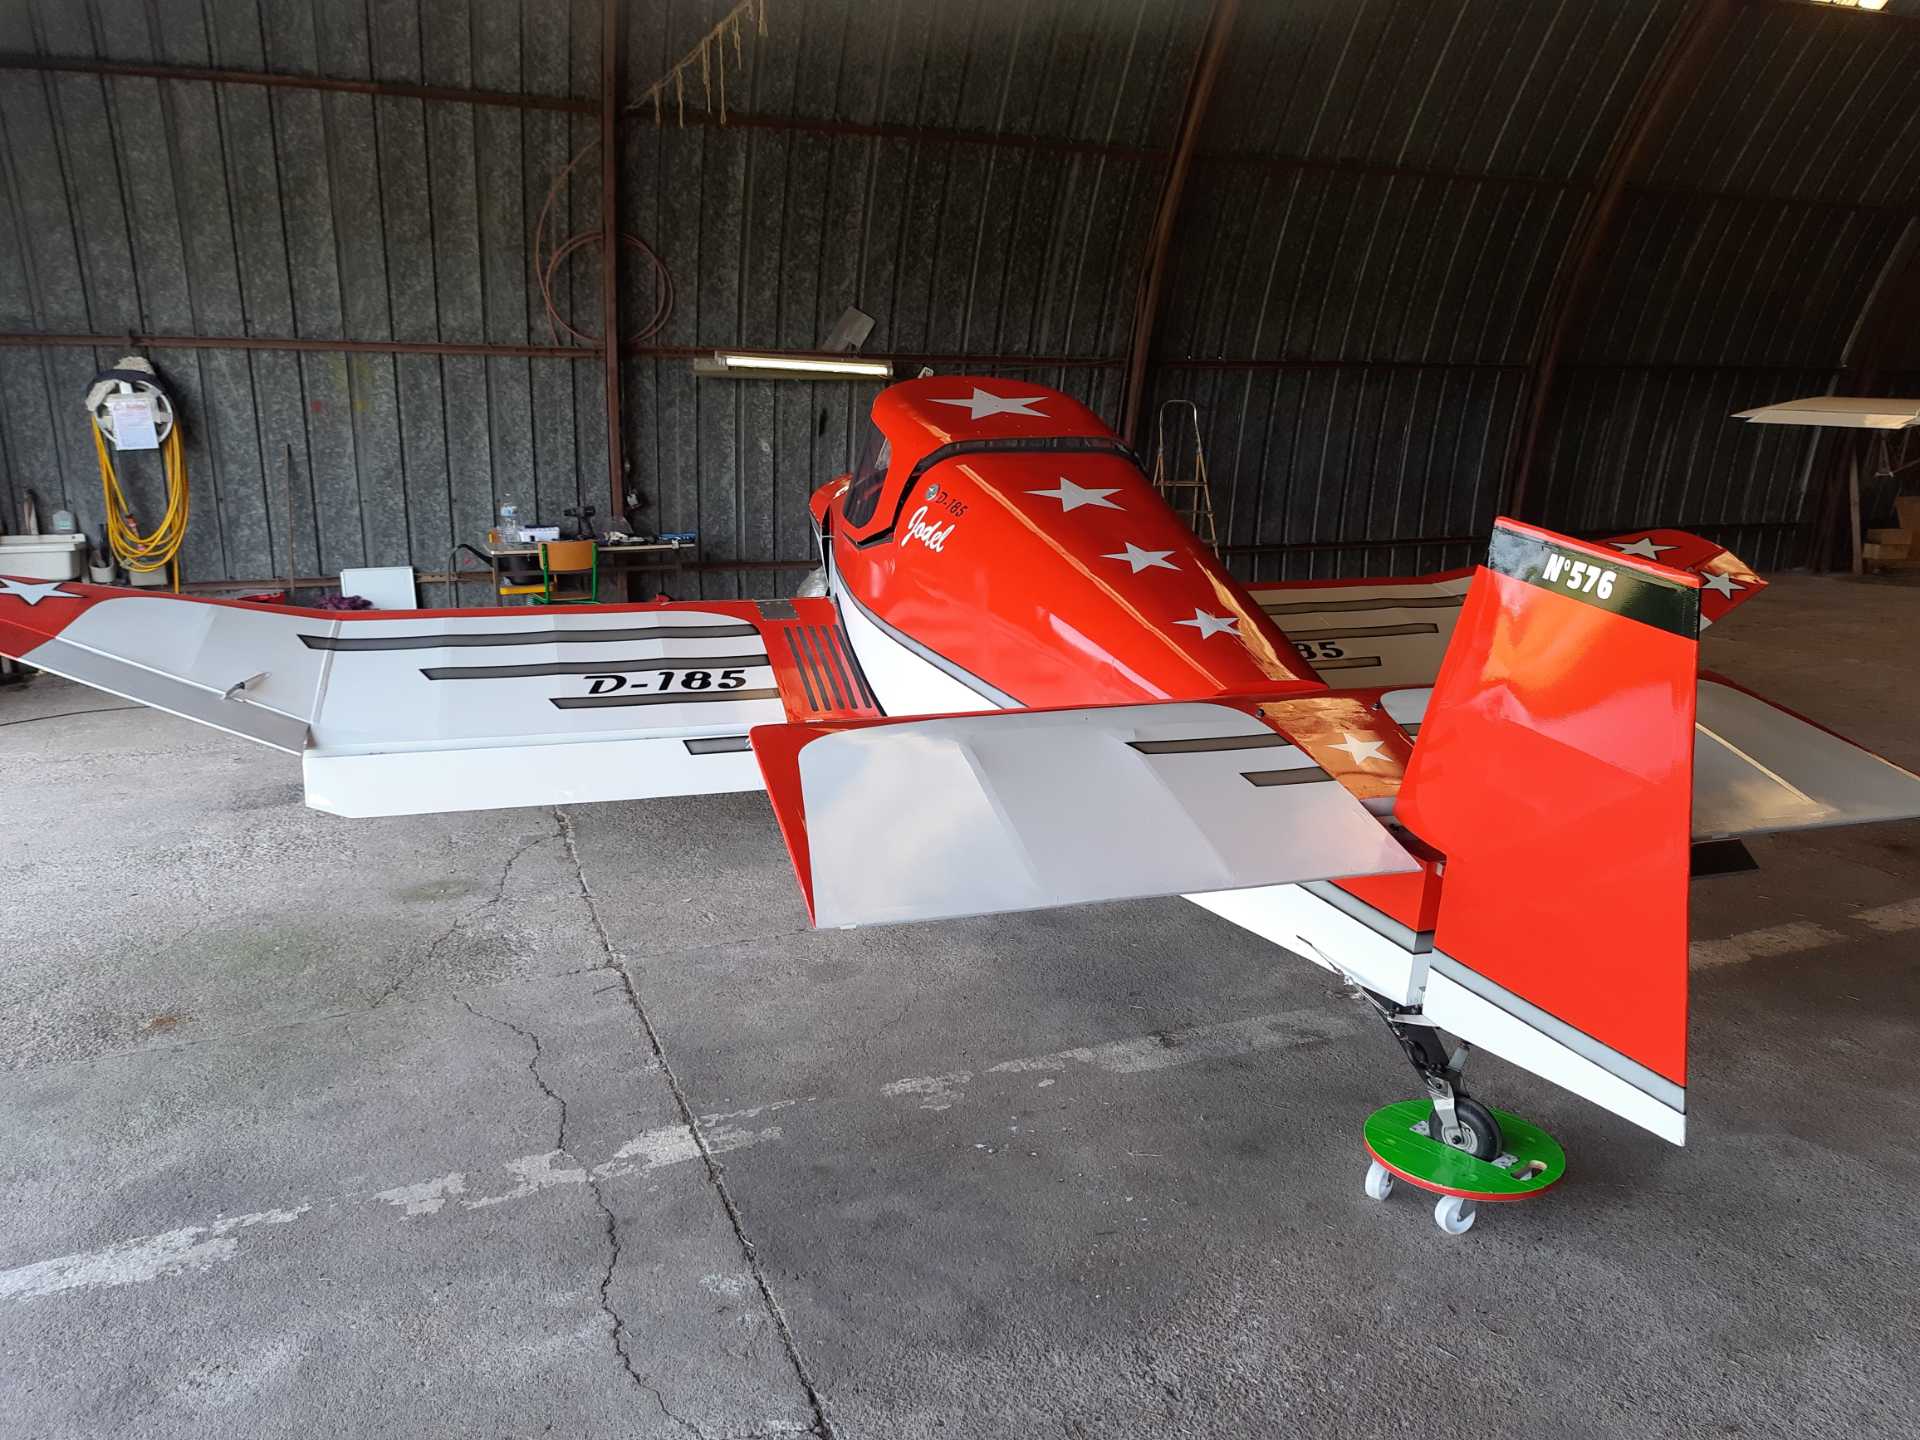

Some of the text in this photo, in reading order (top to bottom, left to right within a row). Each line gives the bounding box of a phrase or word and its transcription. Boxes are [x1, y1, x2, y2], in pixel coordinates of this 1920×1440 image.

[936, 491, 968, 517] D-185
[901, 505, 955, 552] Jodel
[1542, 553, 1617, 600] N°576
[583, 669, 747, 695] D-185
